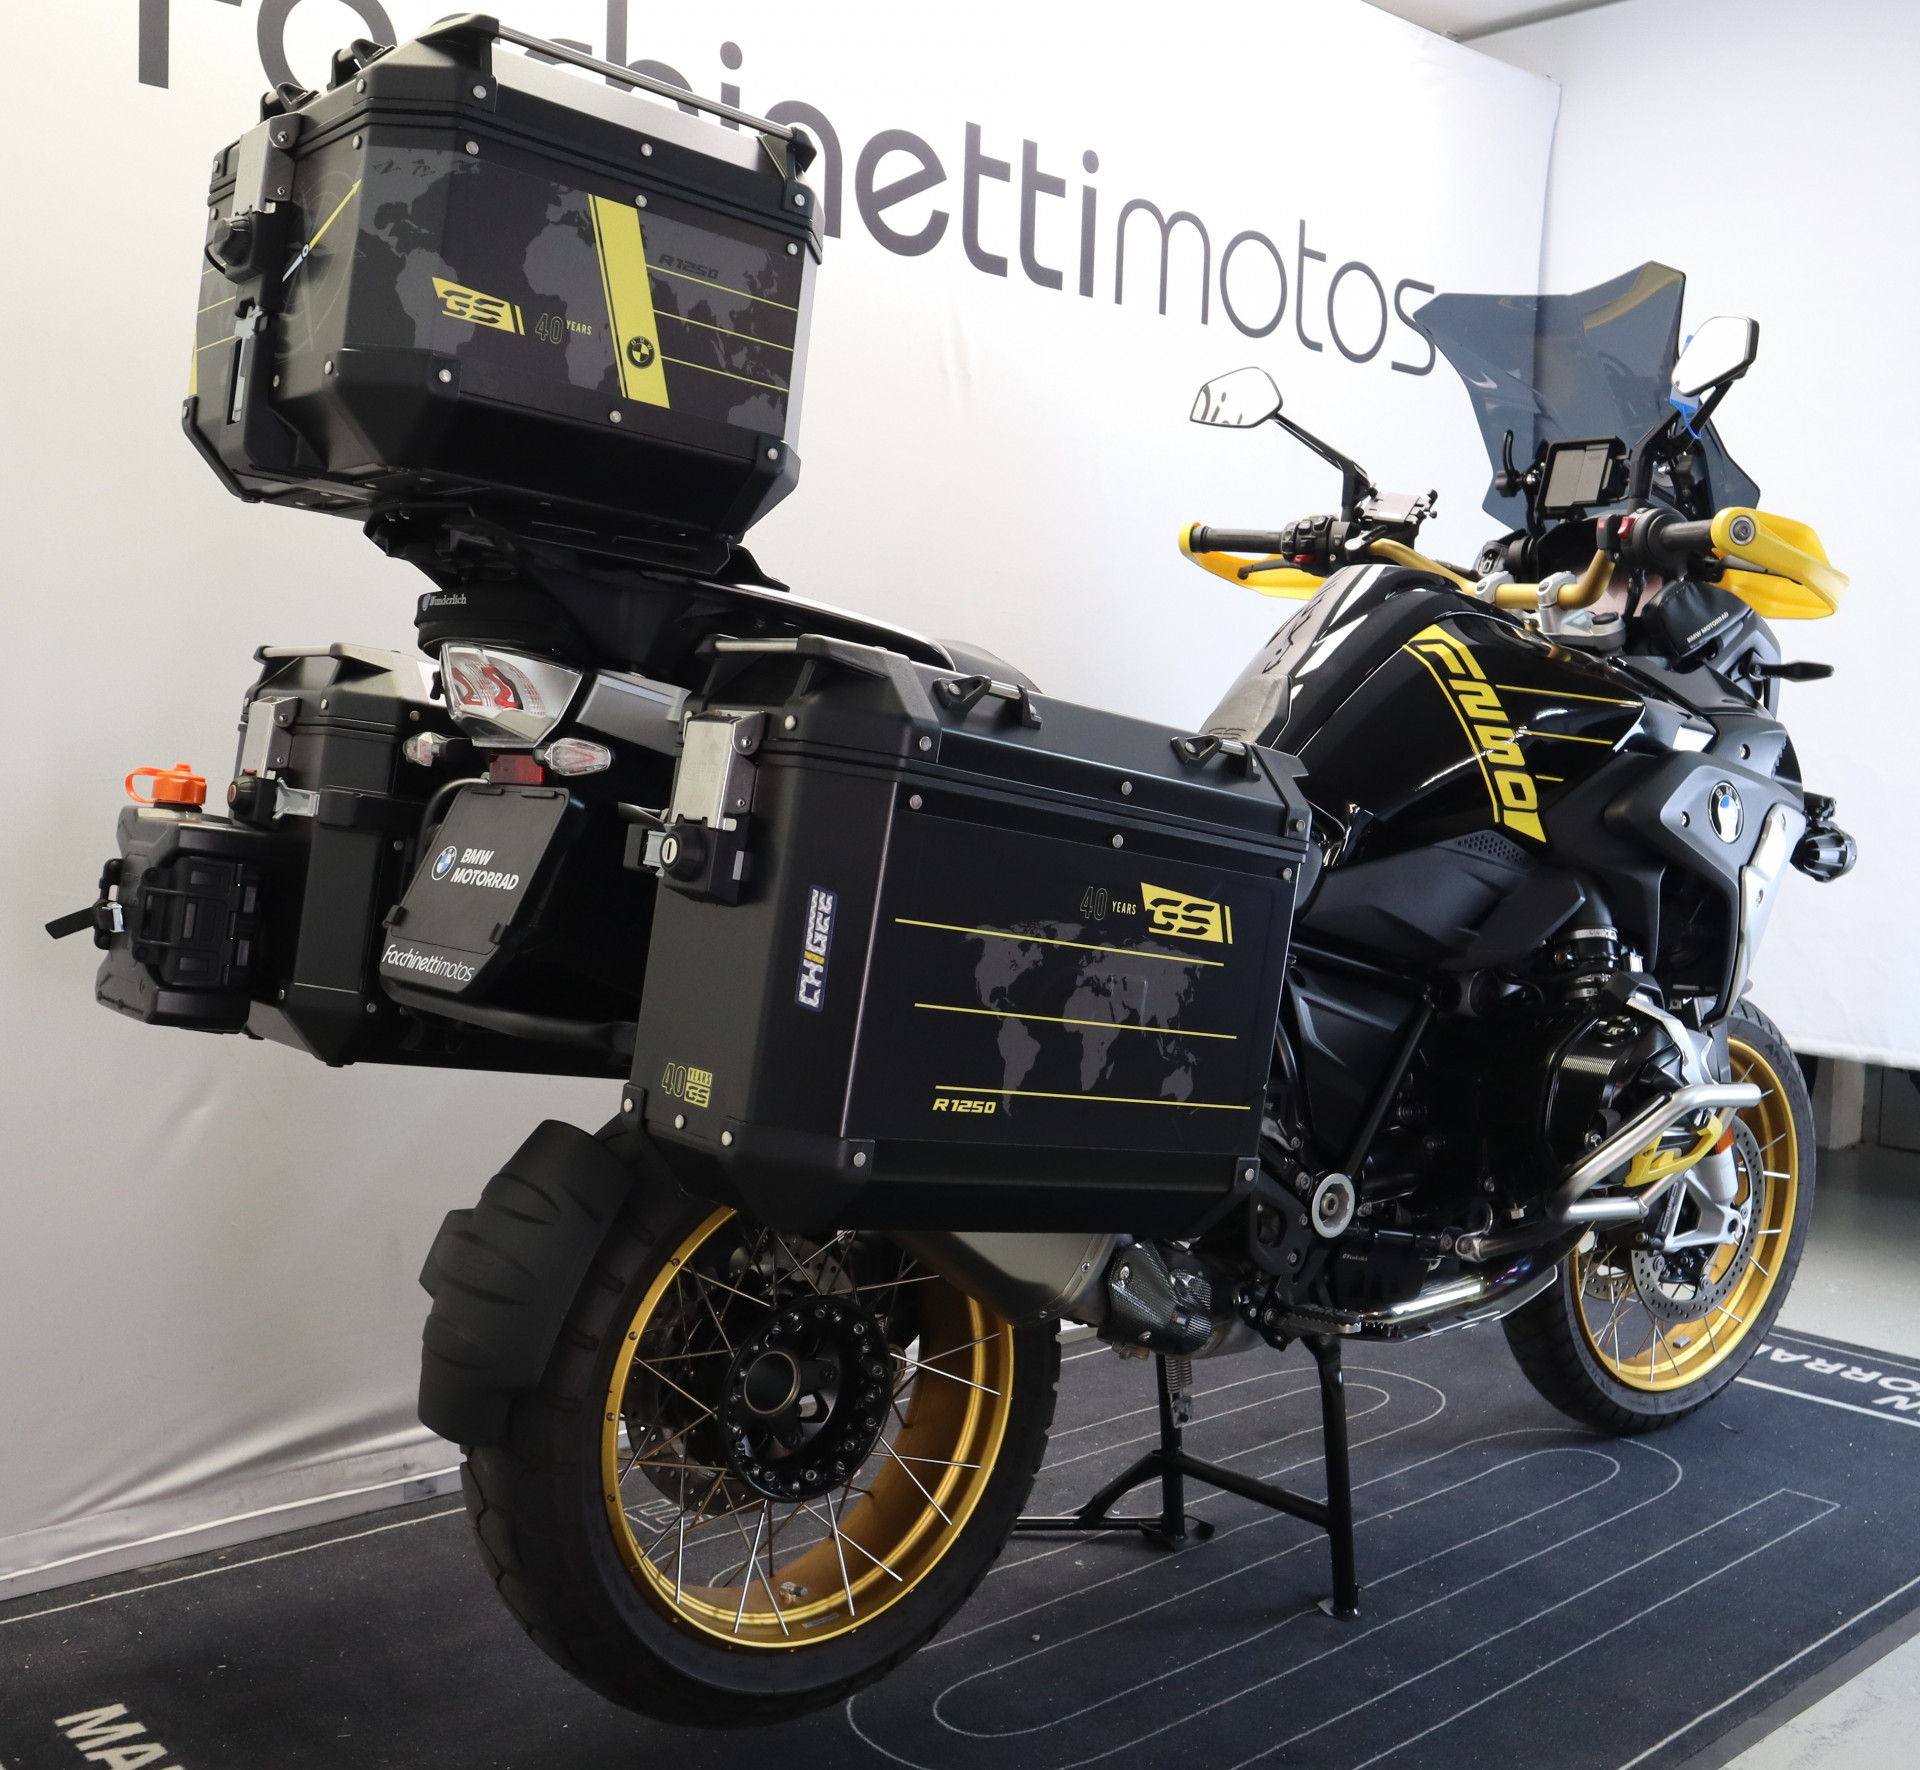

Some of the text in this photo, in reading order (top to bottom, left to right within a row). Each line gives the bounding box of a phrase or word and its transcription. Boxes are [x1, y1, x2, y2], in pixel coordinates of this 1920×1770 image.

[535, 313, 564, 344] 40
[566, 319, 592, 336] YEARS
[1683, 611, 1729, 643] BMW MOTORRAD
[460, 848, 495, 866] BMW
[450, 867, 520, 890] MOTORRAD
[1080, 886, 1215, 936] 40 YEARS GS
[661, 1062, 712, 1098] 40 YEARS
